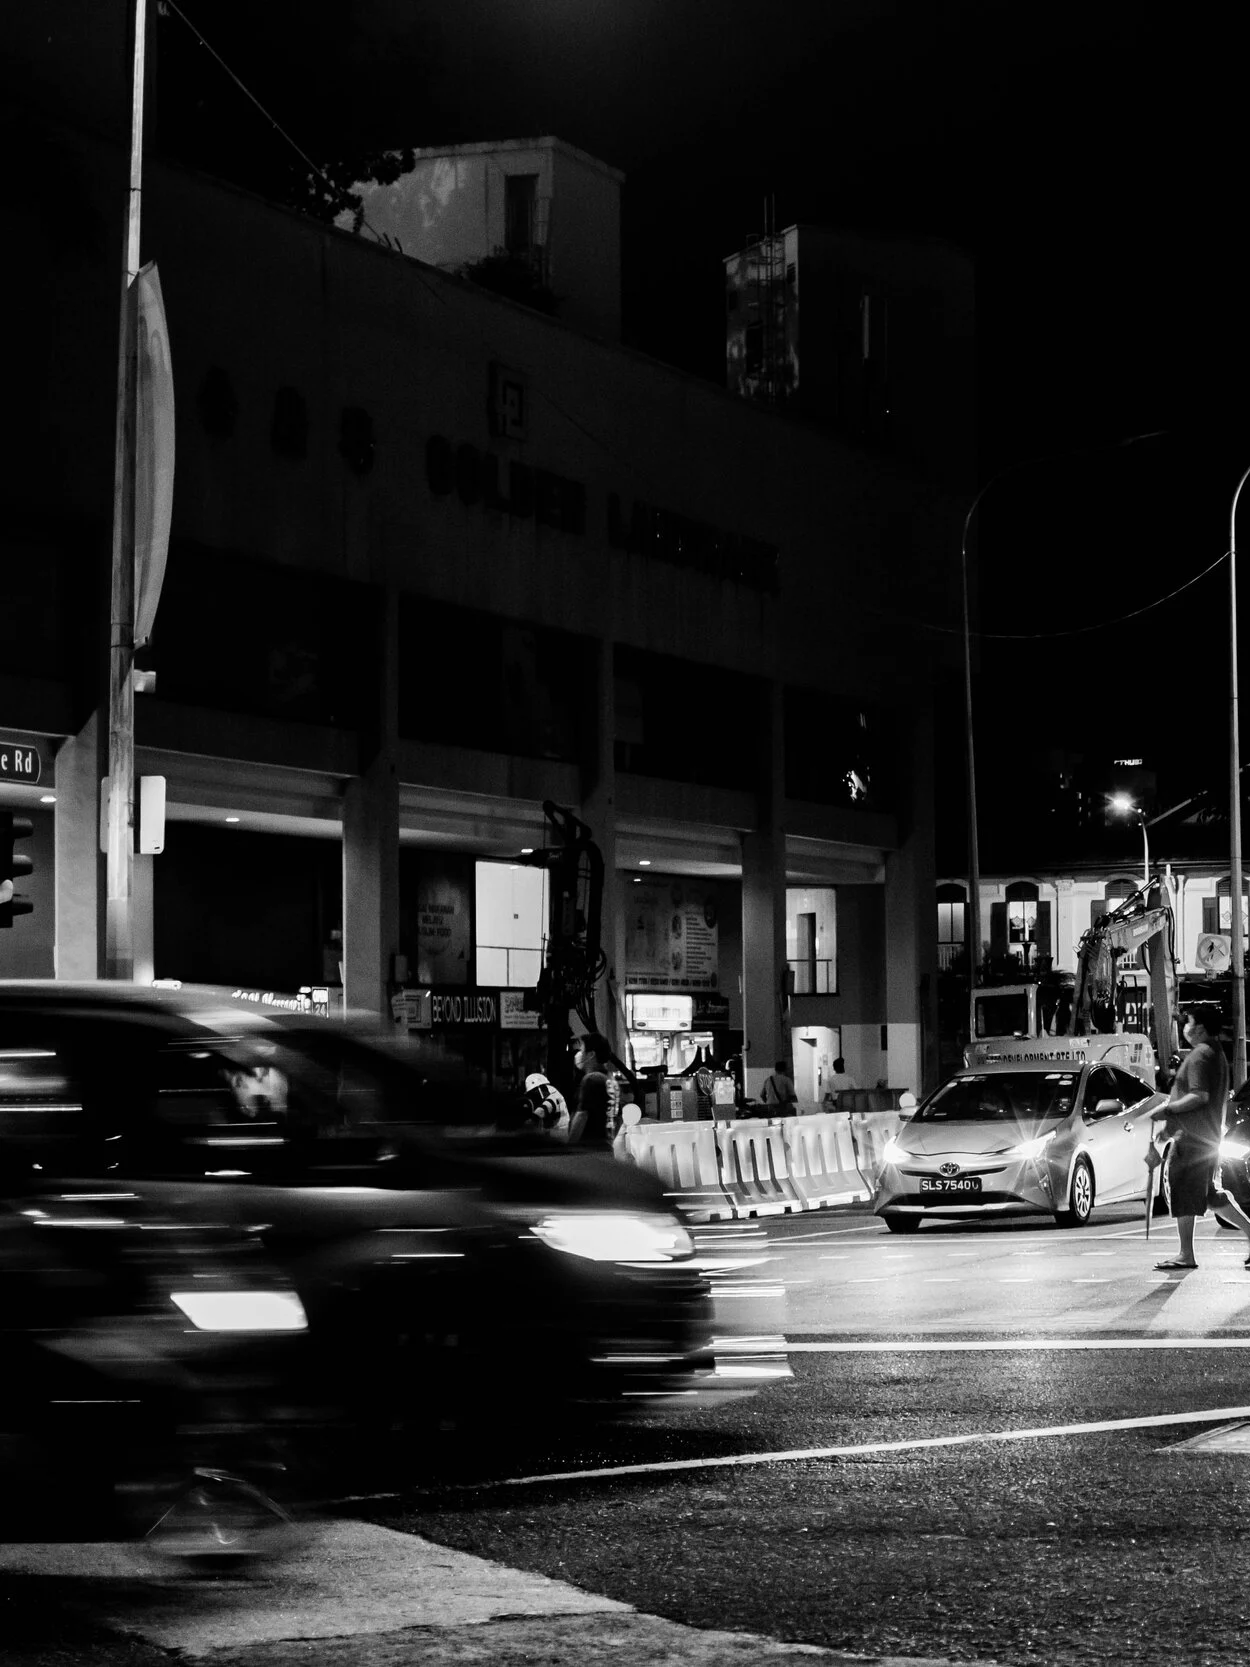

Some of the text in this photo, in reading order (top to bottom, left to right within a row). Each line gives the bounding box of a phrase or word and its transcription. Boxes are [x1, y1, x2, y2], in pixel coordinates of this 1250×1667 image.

[425, 434, 587, 535] GOLDEN
[1, 749, 32, 773] e Rd
[432, 996, 461, 1023] BEYOND
[463, 996, 497, 1023] ILLUSION
